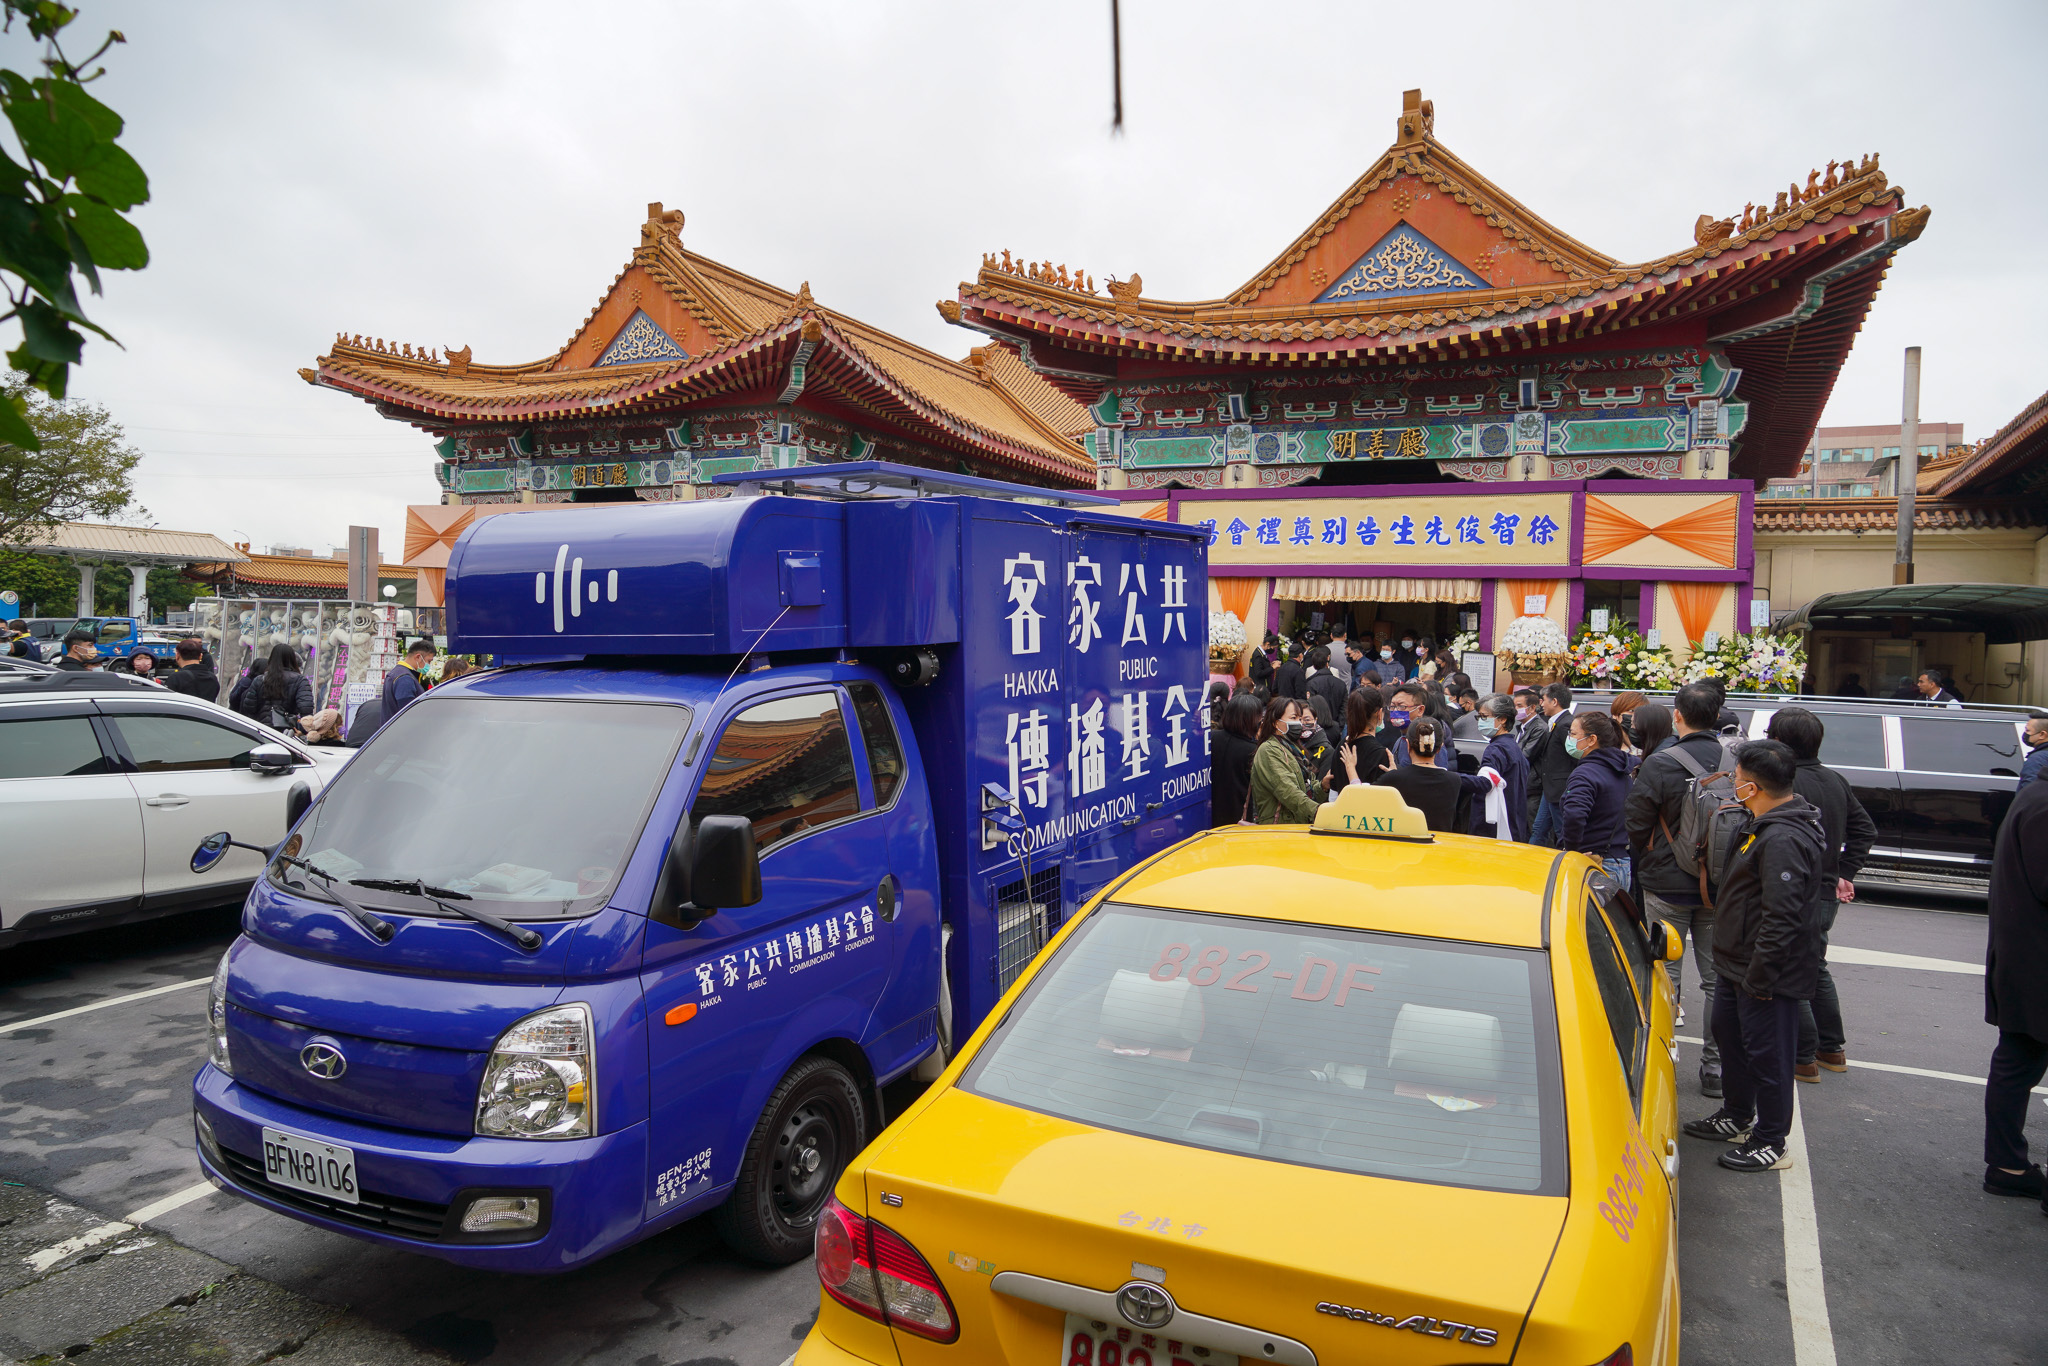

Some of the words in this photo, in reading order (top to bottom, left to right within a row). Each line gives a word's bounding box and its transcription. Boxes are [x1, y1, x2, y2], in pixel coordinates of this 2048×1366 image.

[1333, 428, 1426, 459] 明善廳
[573, 463, 628, 487] 明道廳
[1003, 552, 1188, 655] 客家公共
[1004, 668, 1059, 698] HAKKA
[1119, 656, 1158, 682] PUBLIC
[1007, 793, 1136, 858] COMMUNICATION
[1342, 814, 1395, 833] TAXI
[51, 908, 98, 920] OUTBACK
[695, 905, 874, 996] 客家公共傳播基金會
[700, 995, 722, 1010] HAKKA
[747, 977, 768, 991] PUBLIC
[789, 950, 835, 975] COMMUNICATION
[844, 934, 875, 952] FOUNDATION
[1149, 942, 1383, 1008] 882-DF
[657, 1147, 712, 1185] BFN-8106
[1598, 1141, 1646, 1244] 882-DF
[1117, 1210, 1209, 1240] 台北市
[1315, 1301, 1395, 1328] COROLLA
[1394, 1315, 1498, 1347] ALTIS
